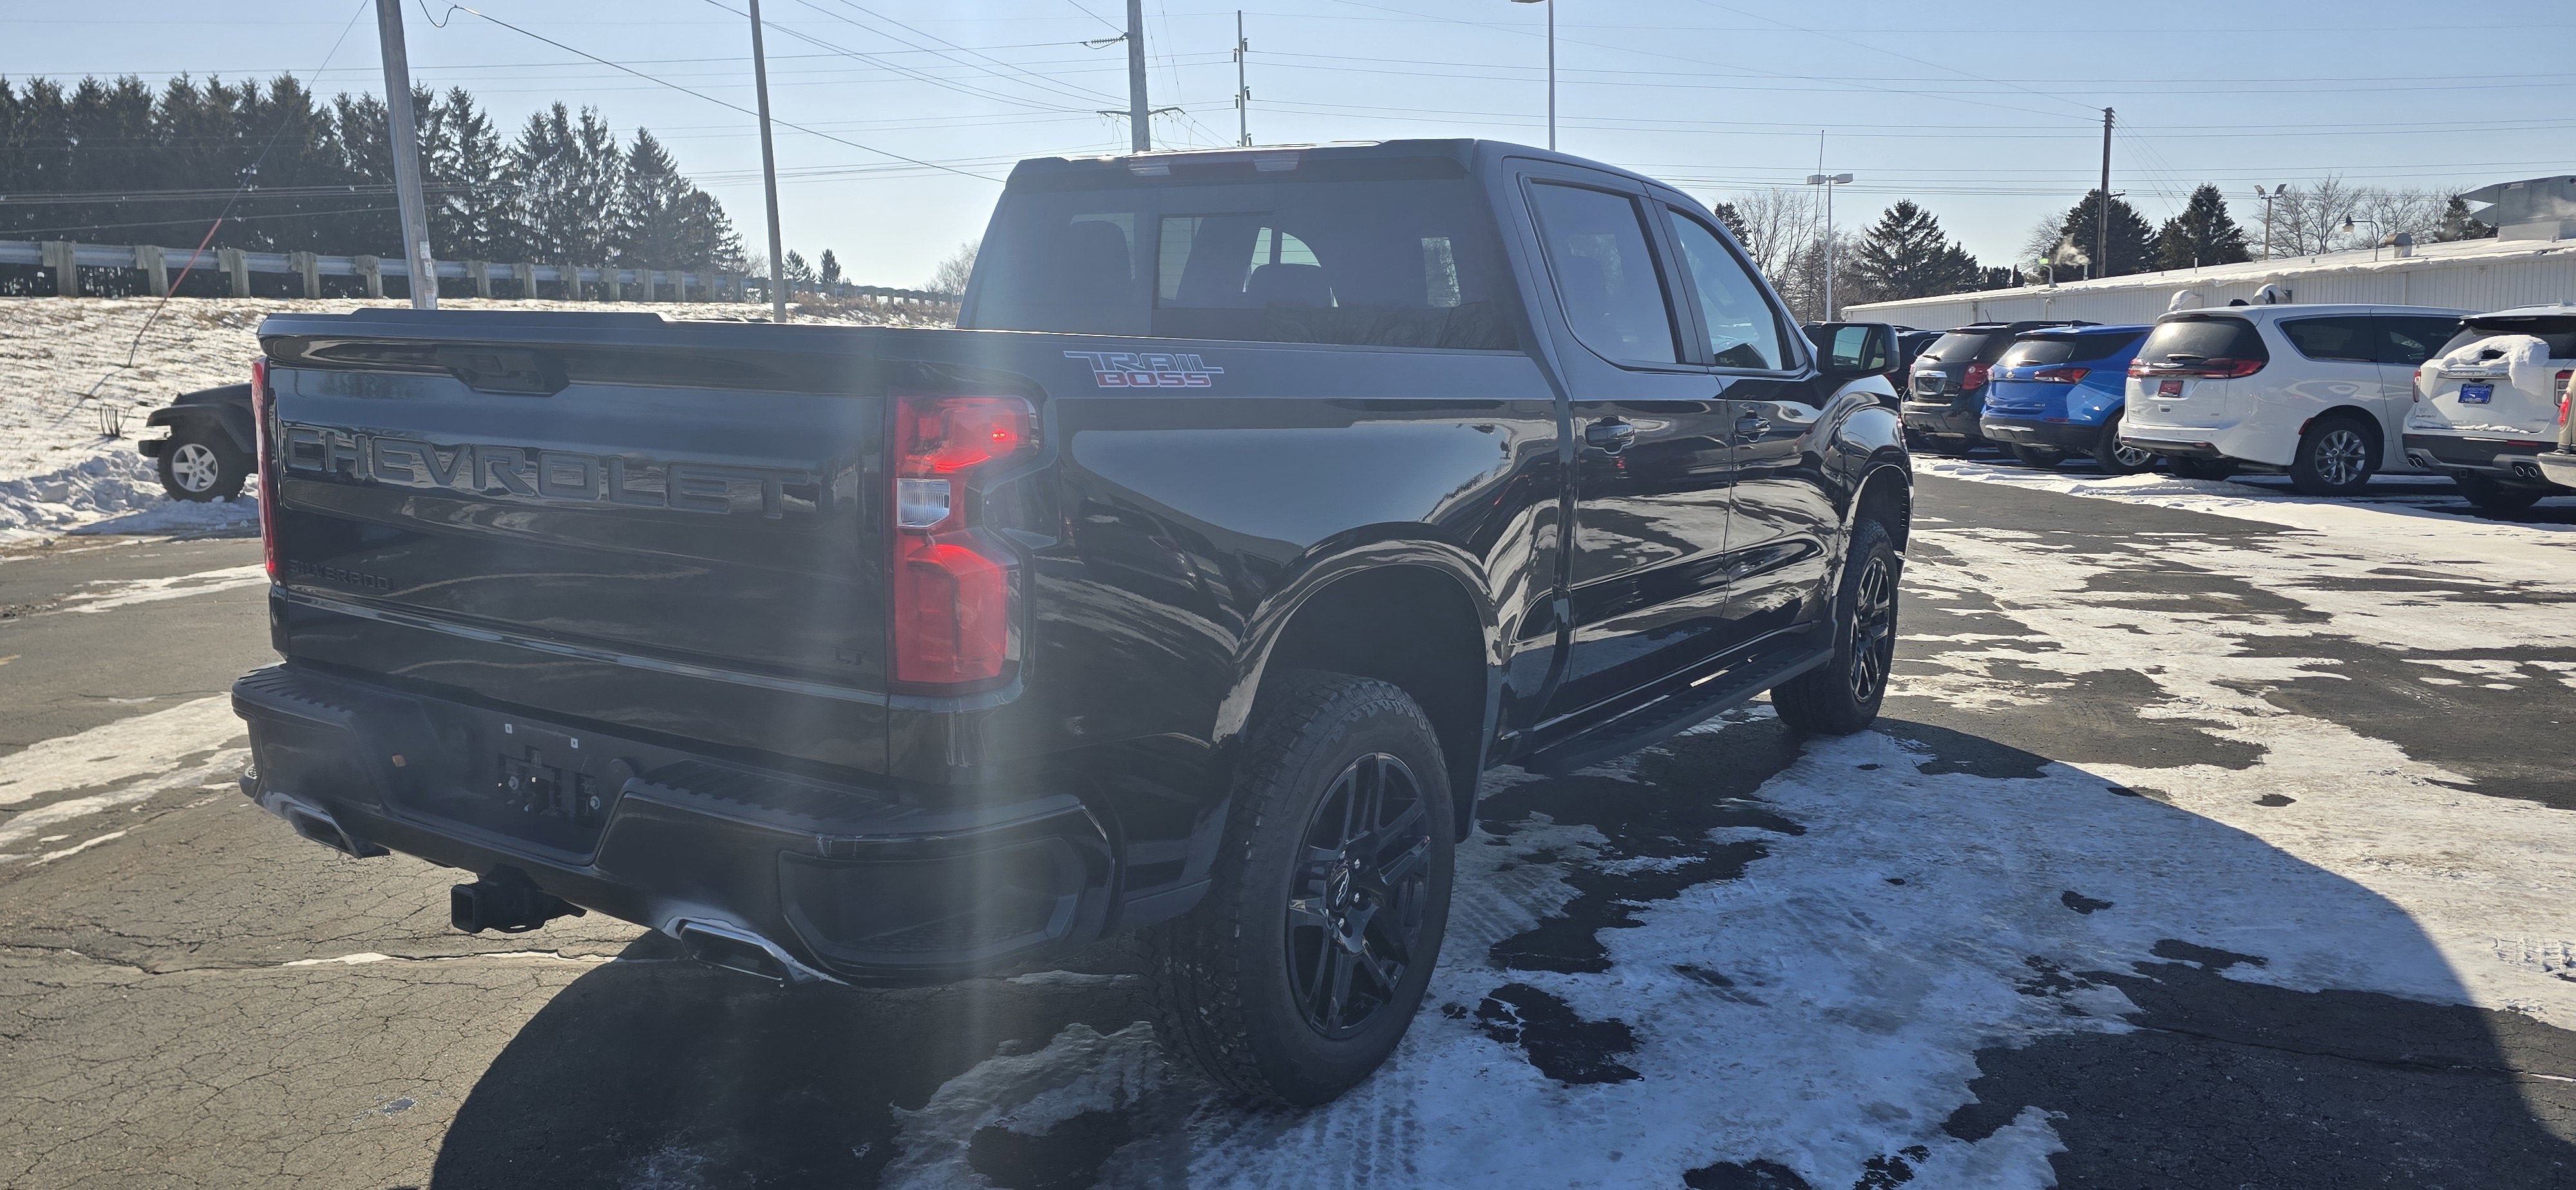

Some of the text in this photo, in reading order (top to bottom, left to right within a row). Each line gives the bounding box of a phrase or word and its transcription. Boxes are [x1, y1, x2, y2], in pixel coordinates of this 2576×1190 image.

[1063, 350, 1224, 373] TRAIL
[1095, 370, 1211, 388] BOSS
[285, 428, 811, 518] CHEVROLET
[288, 559, 395, 590] SILVERADO
[833, 647, 867, 665] LT
